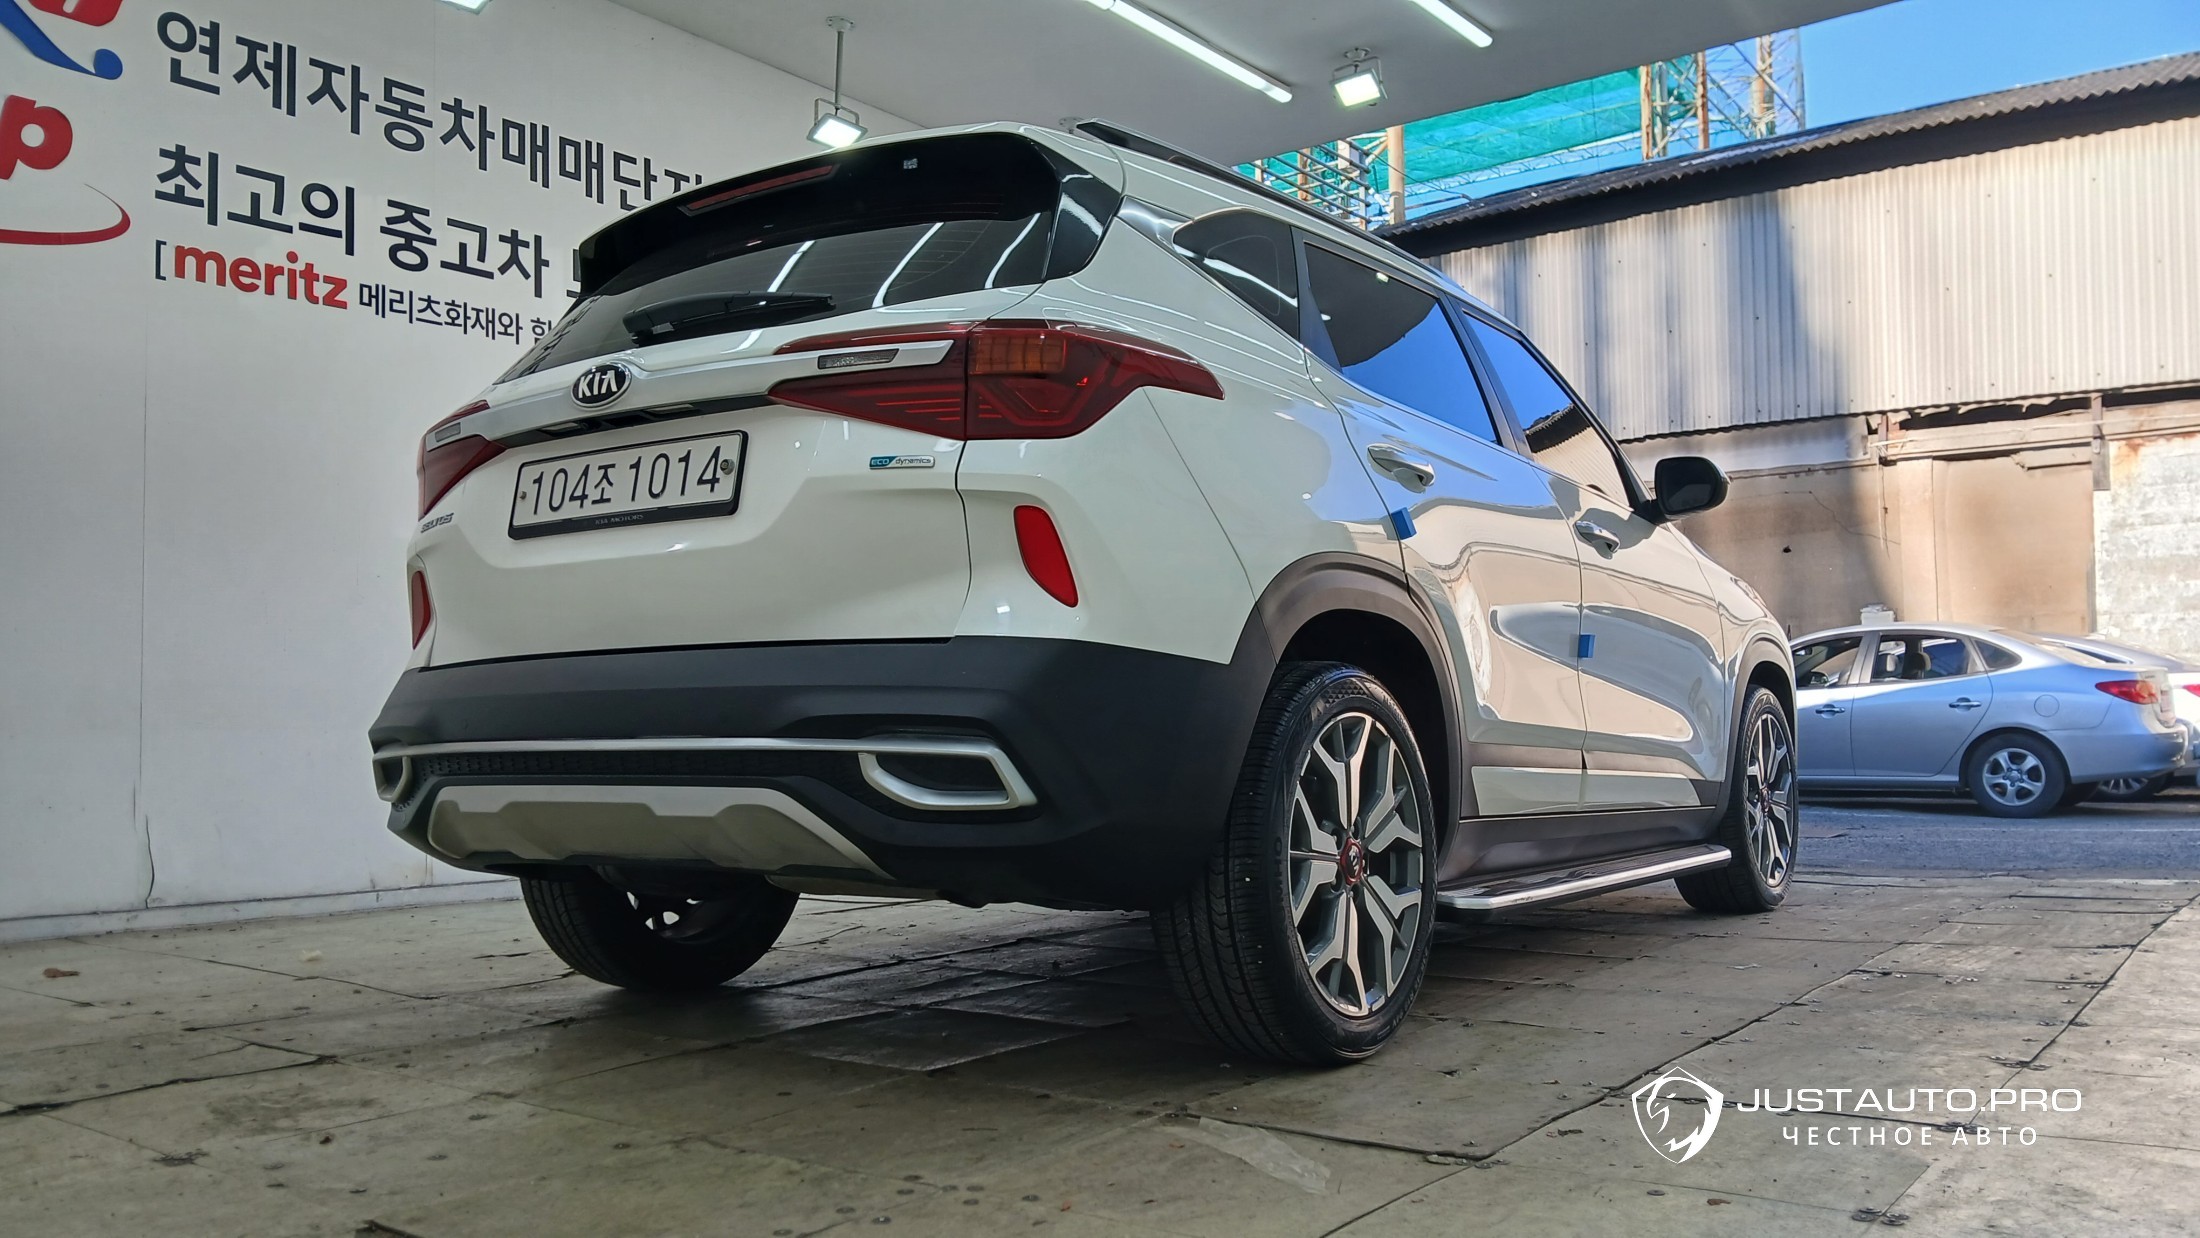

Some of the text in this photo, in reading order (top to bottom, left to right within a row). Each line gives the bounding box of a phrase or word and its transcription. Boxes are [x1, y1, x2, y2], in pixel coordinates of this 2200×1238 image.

[155, 143, 354, 256] 최고의
[378, 198, 549, 299] 중고차
[358, 283, 522, 345] 메리츠화재와
[578, 369, 618, 399] KIA
[532, 446, 721, 515] 104조 1014
